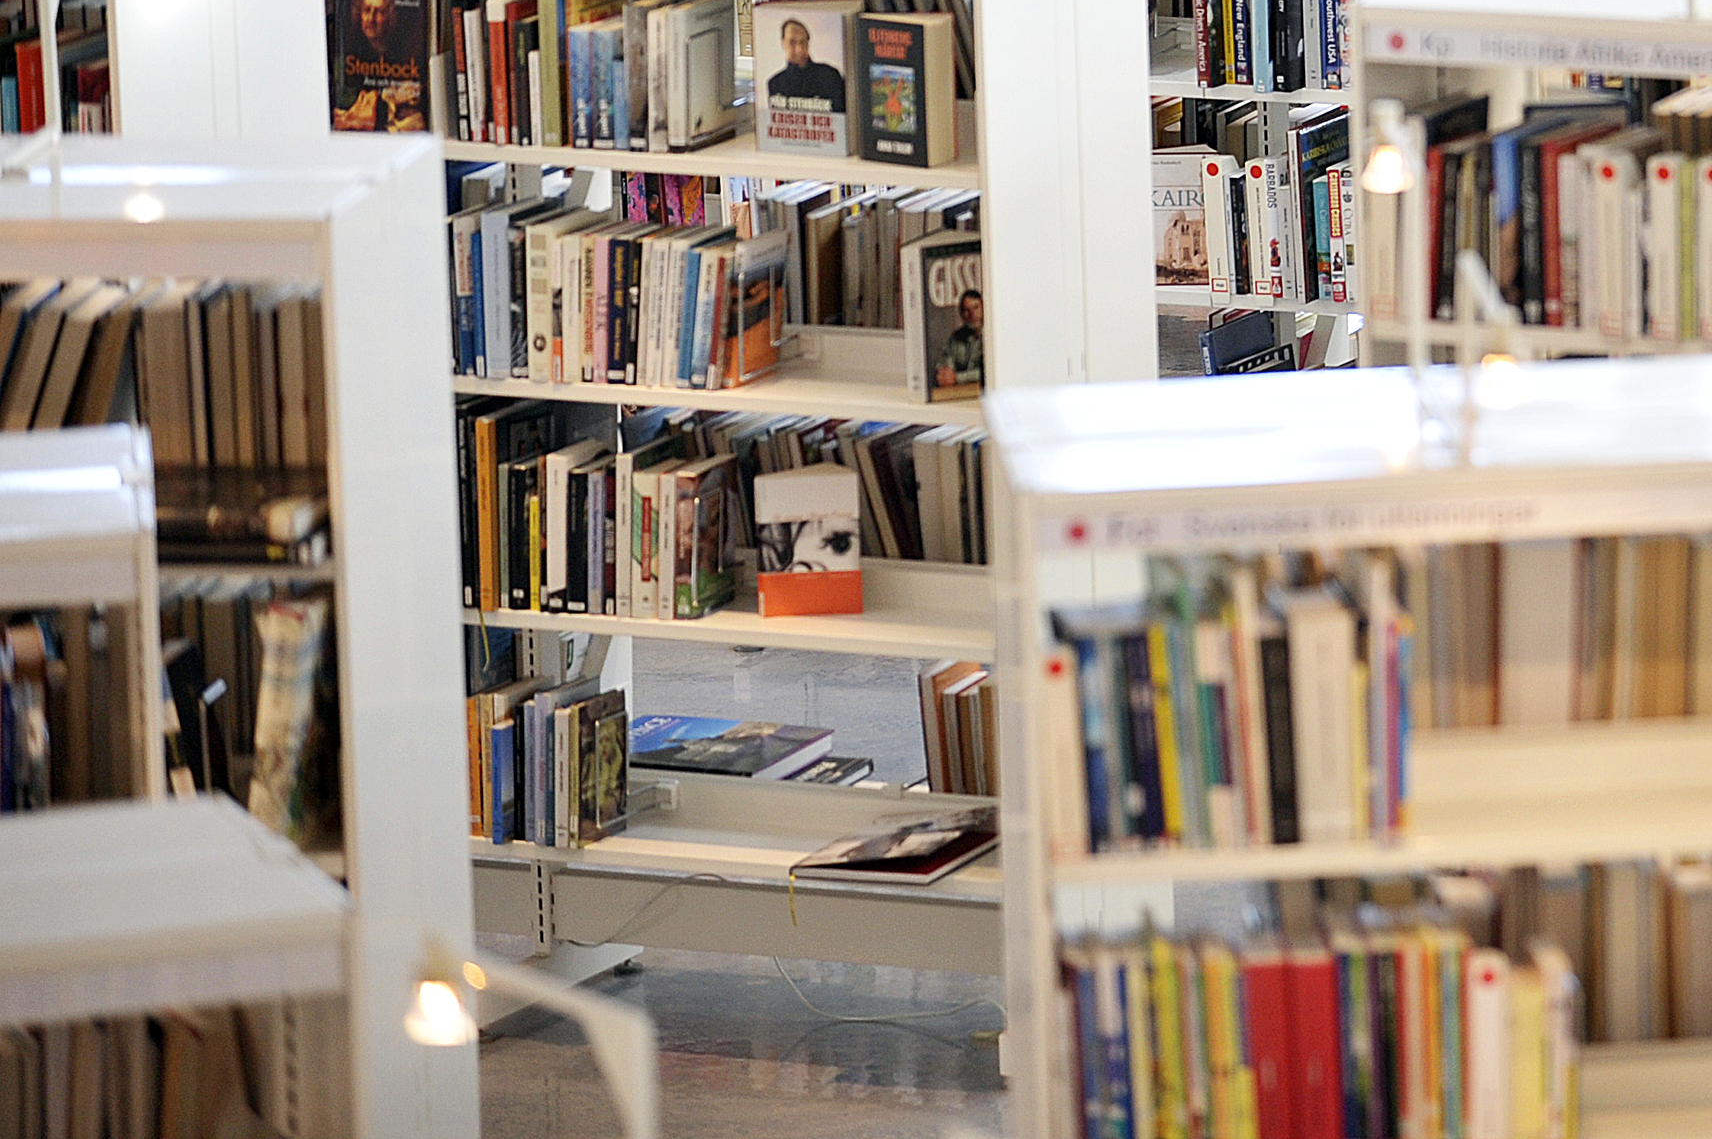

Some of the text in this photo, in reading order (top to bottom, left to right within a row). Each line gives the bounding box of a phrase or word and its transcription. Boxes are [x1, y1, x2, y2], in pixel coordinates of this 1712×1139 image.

[1195, 8, 1206, 32] Drives
[1235, 0, 1245, 61] New England
[345, 56, 420, 80] Stenbock
[1197, 41, 1208, 72] America
[1327, 45, 1336, 64] USA
[1265, 164, 1277, 209] BARBADOS
